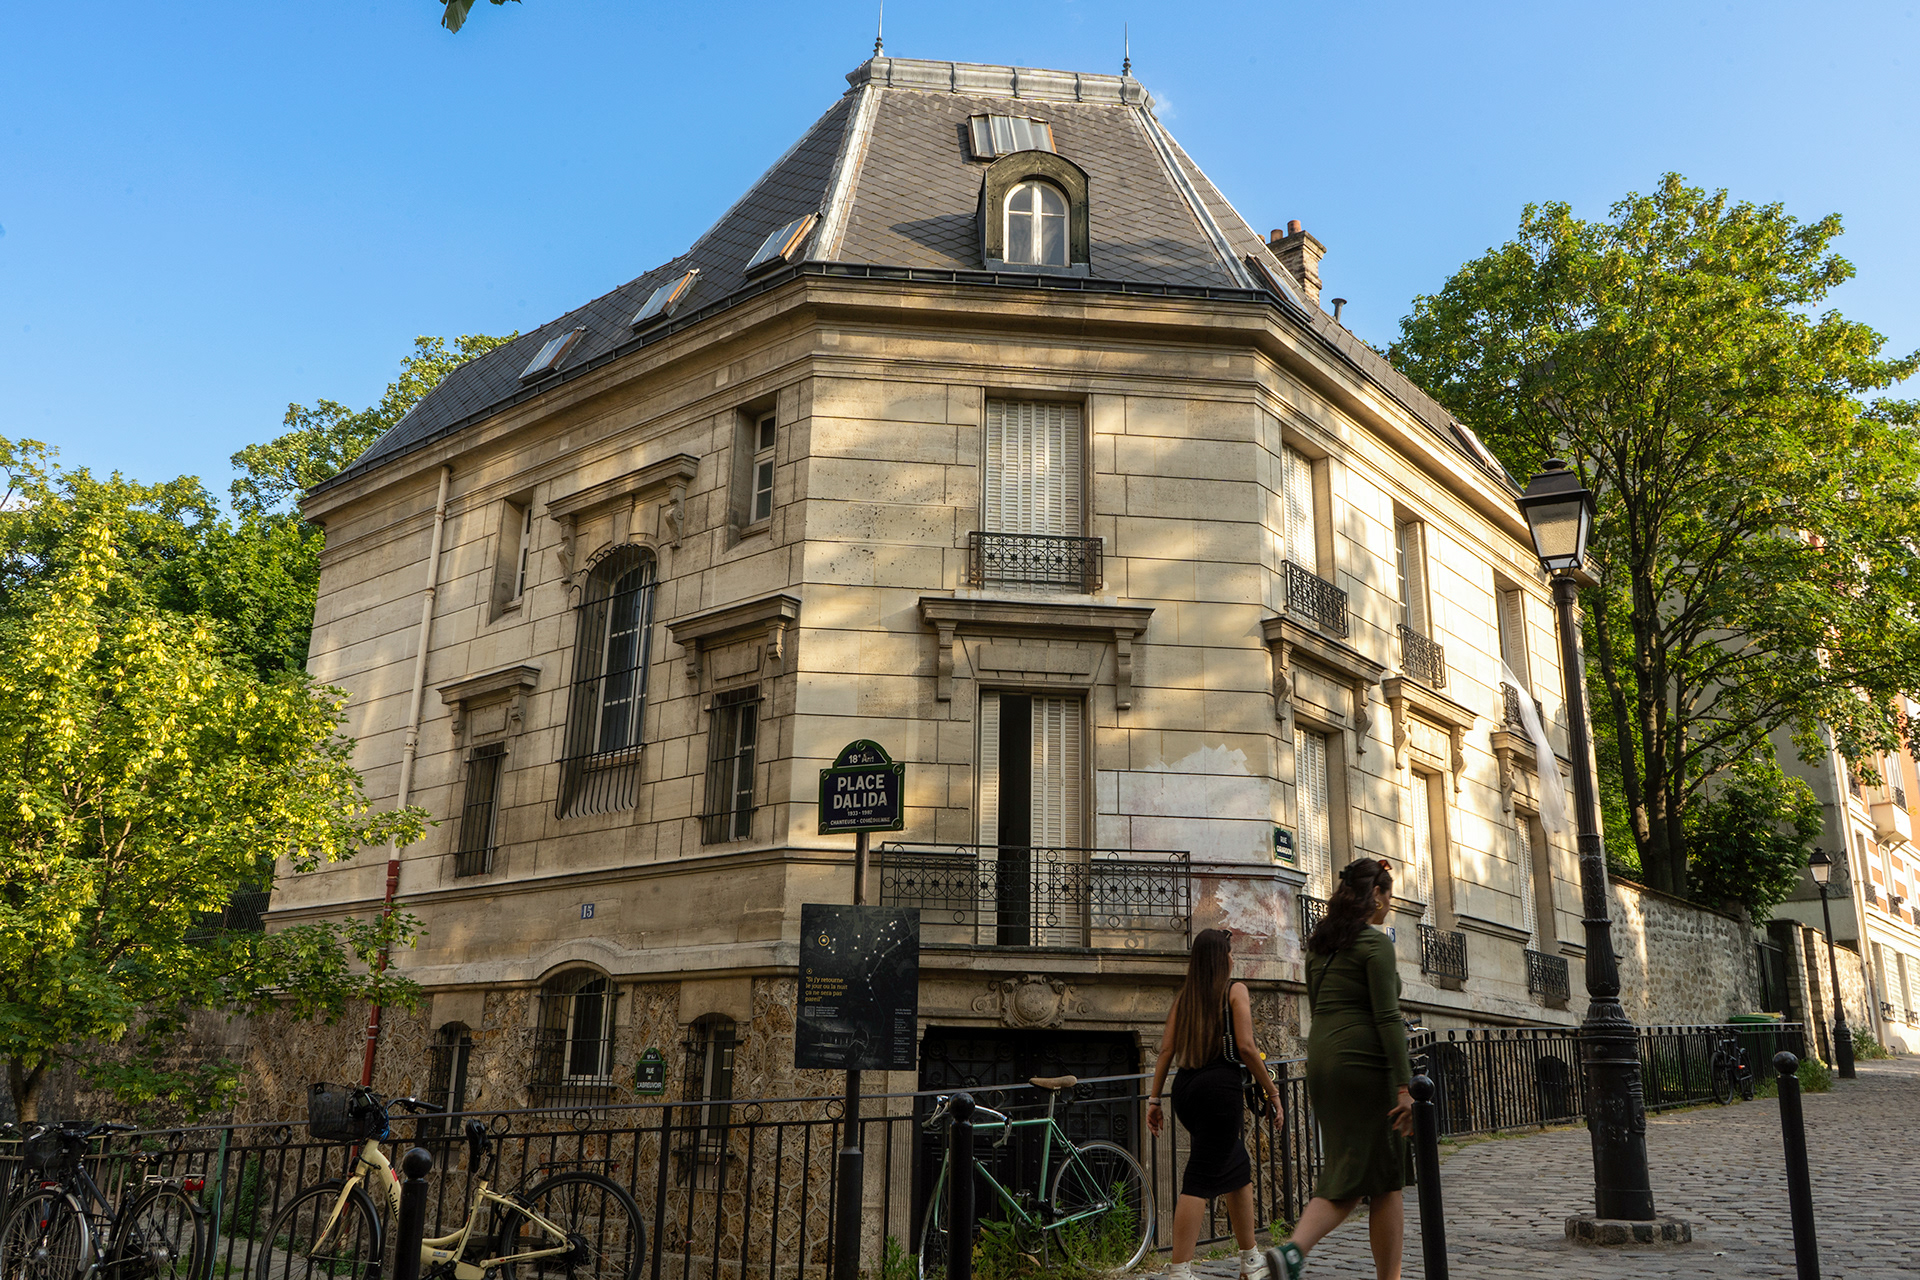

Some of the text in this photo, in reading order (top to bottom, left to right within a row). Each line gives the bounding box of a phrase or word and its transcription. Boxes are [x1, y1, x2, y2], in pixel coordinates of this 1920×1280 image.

[837, 774, 885, 792] PLACE
[833, 791, 888, 810] DALIDA
[830, 818, 857, 826] CHANTEUSE
[582, 905, 593, 918] 15
